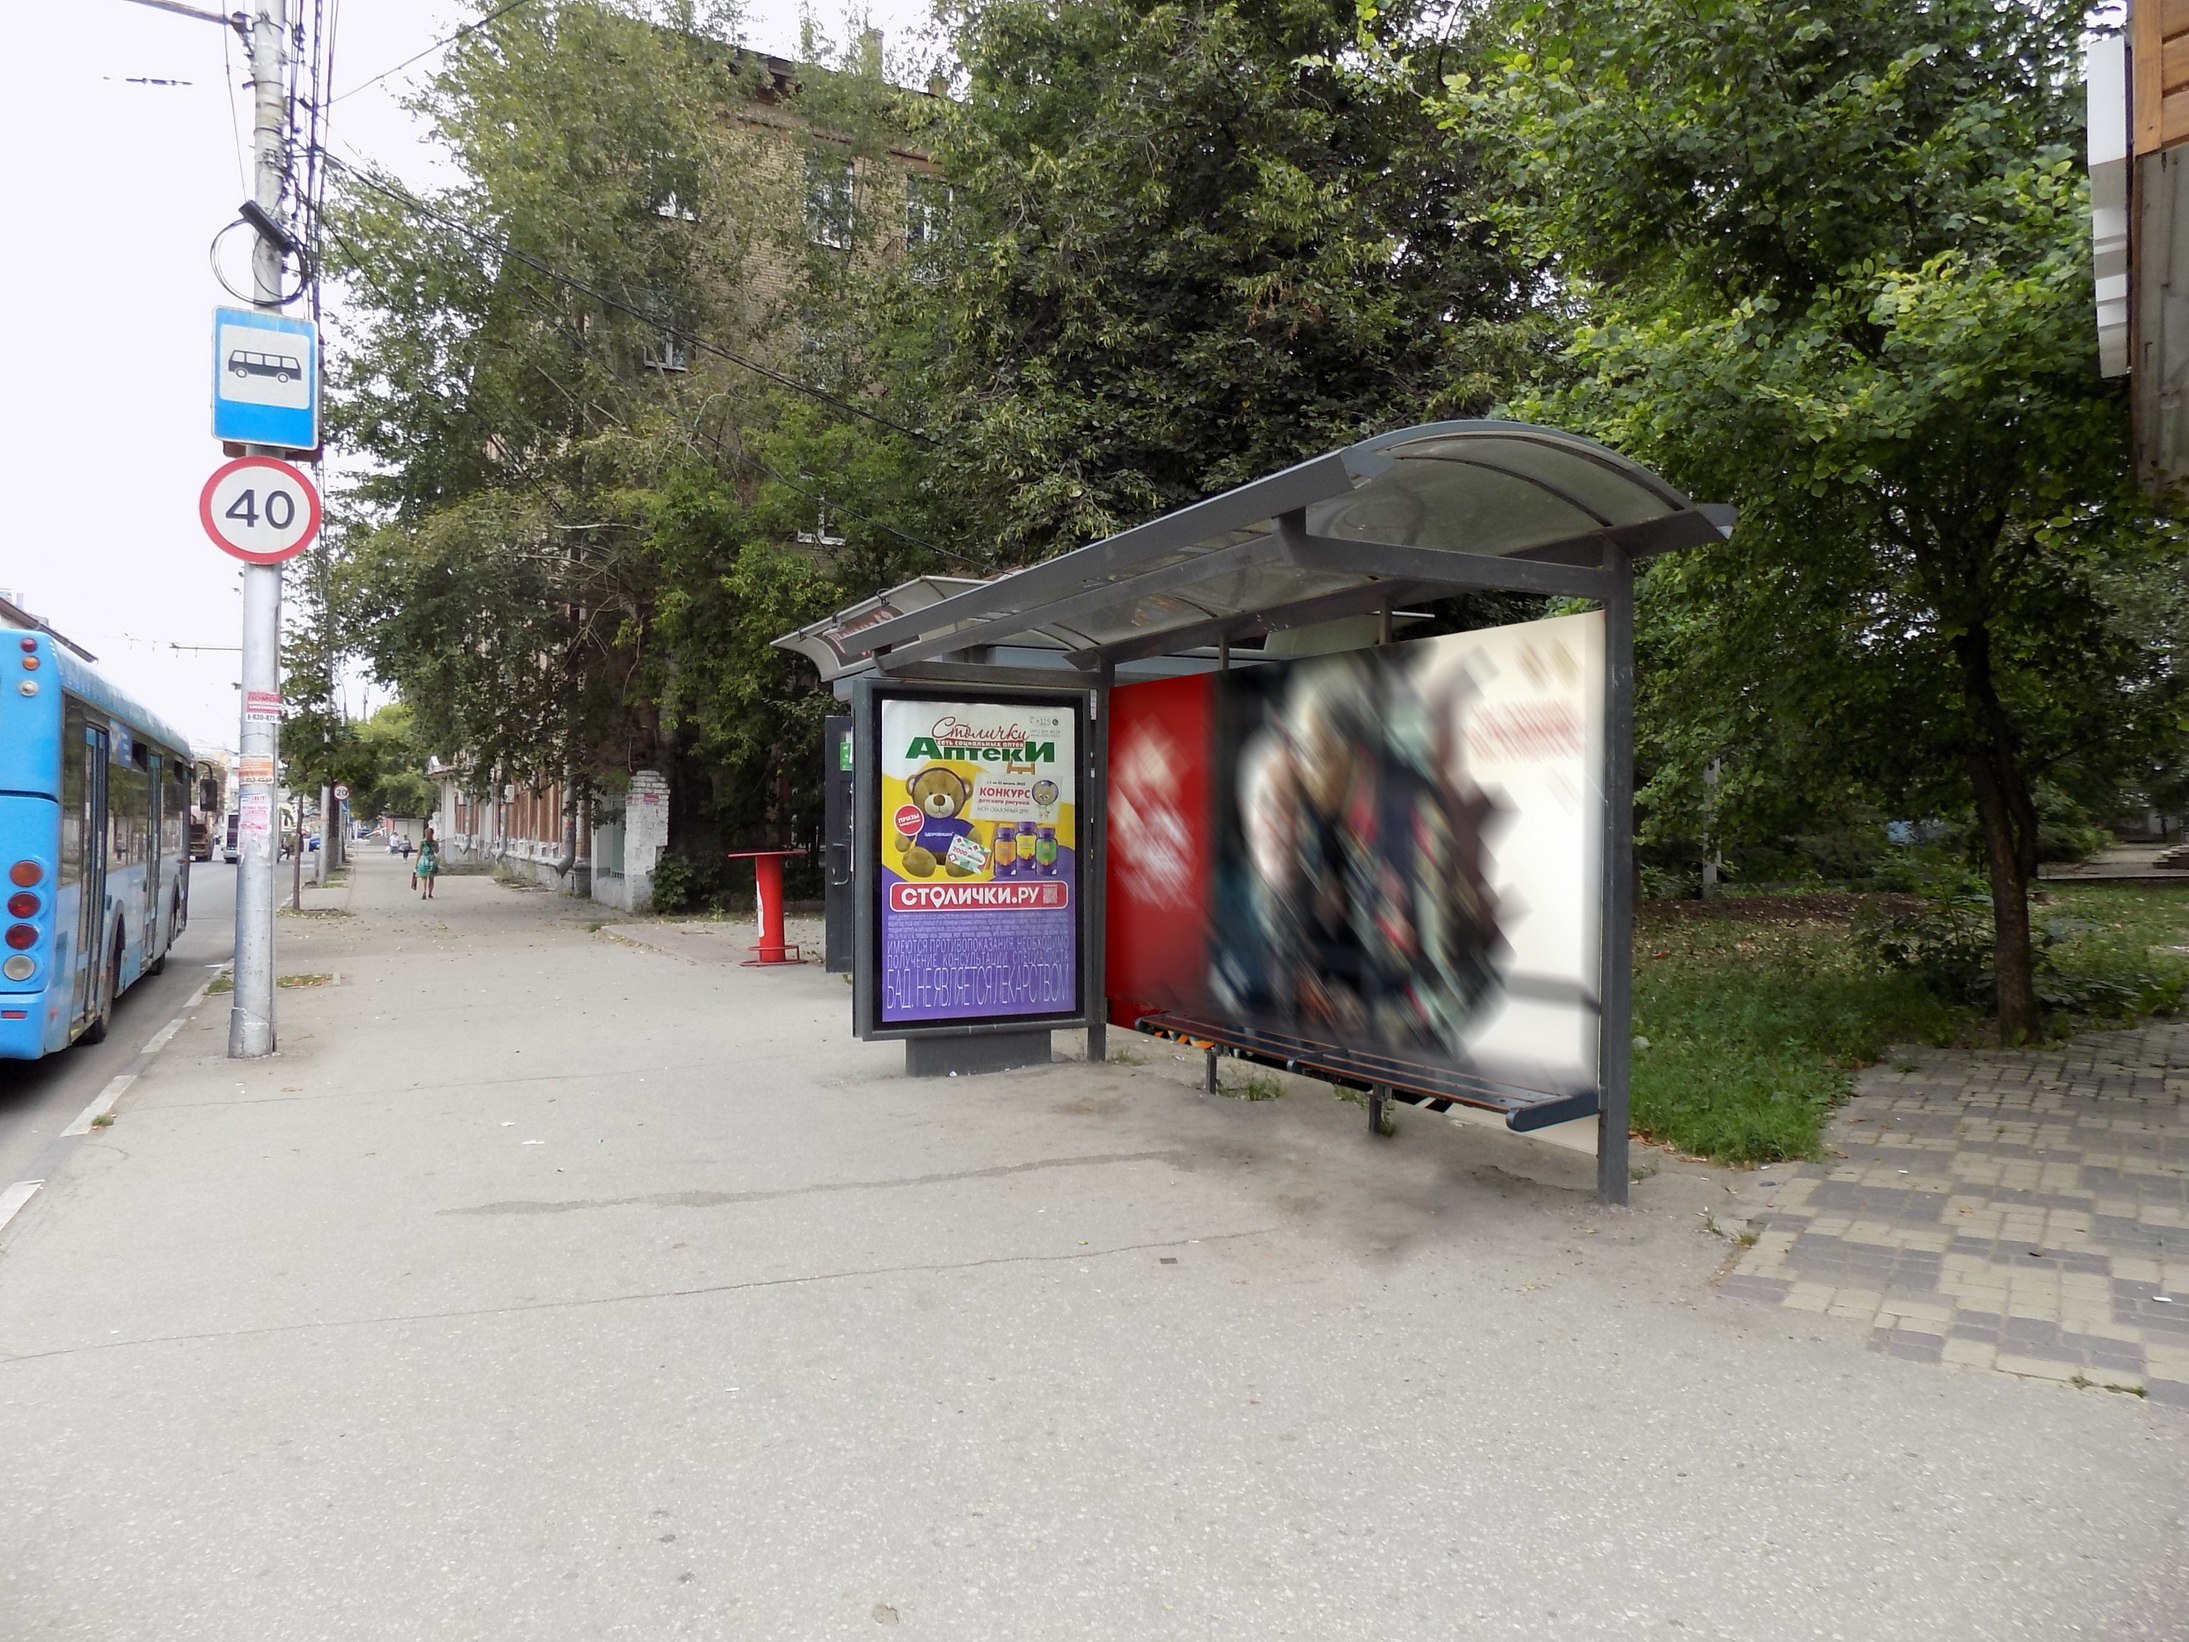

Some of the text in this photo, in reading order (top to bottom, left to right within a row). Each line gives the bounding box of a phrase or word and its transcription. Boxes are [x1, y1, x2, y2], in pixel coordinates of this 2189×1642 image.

[225, 489, 295, 530] 40
[931, 716, 1030, 741] Столички
[979, 787, 1031, 799] КОНКУРС
[887, 939, 928, 955] ИМЕЮТСЯ
[887, 953, 938, 969] ПОЛУЧЕНИЕ
[943, 951, 1008, 967] КОНСУЛЬТАЦИИ
